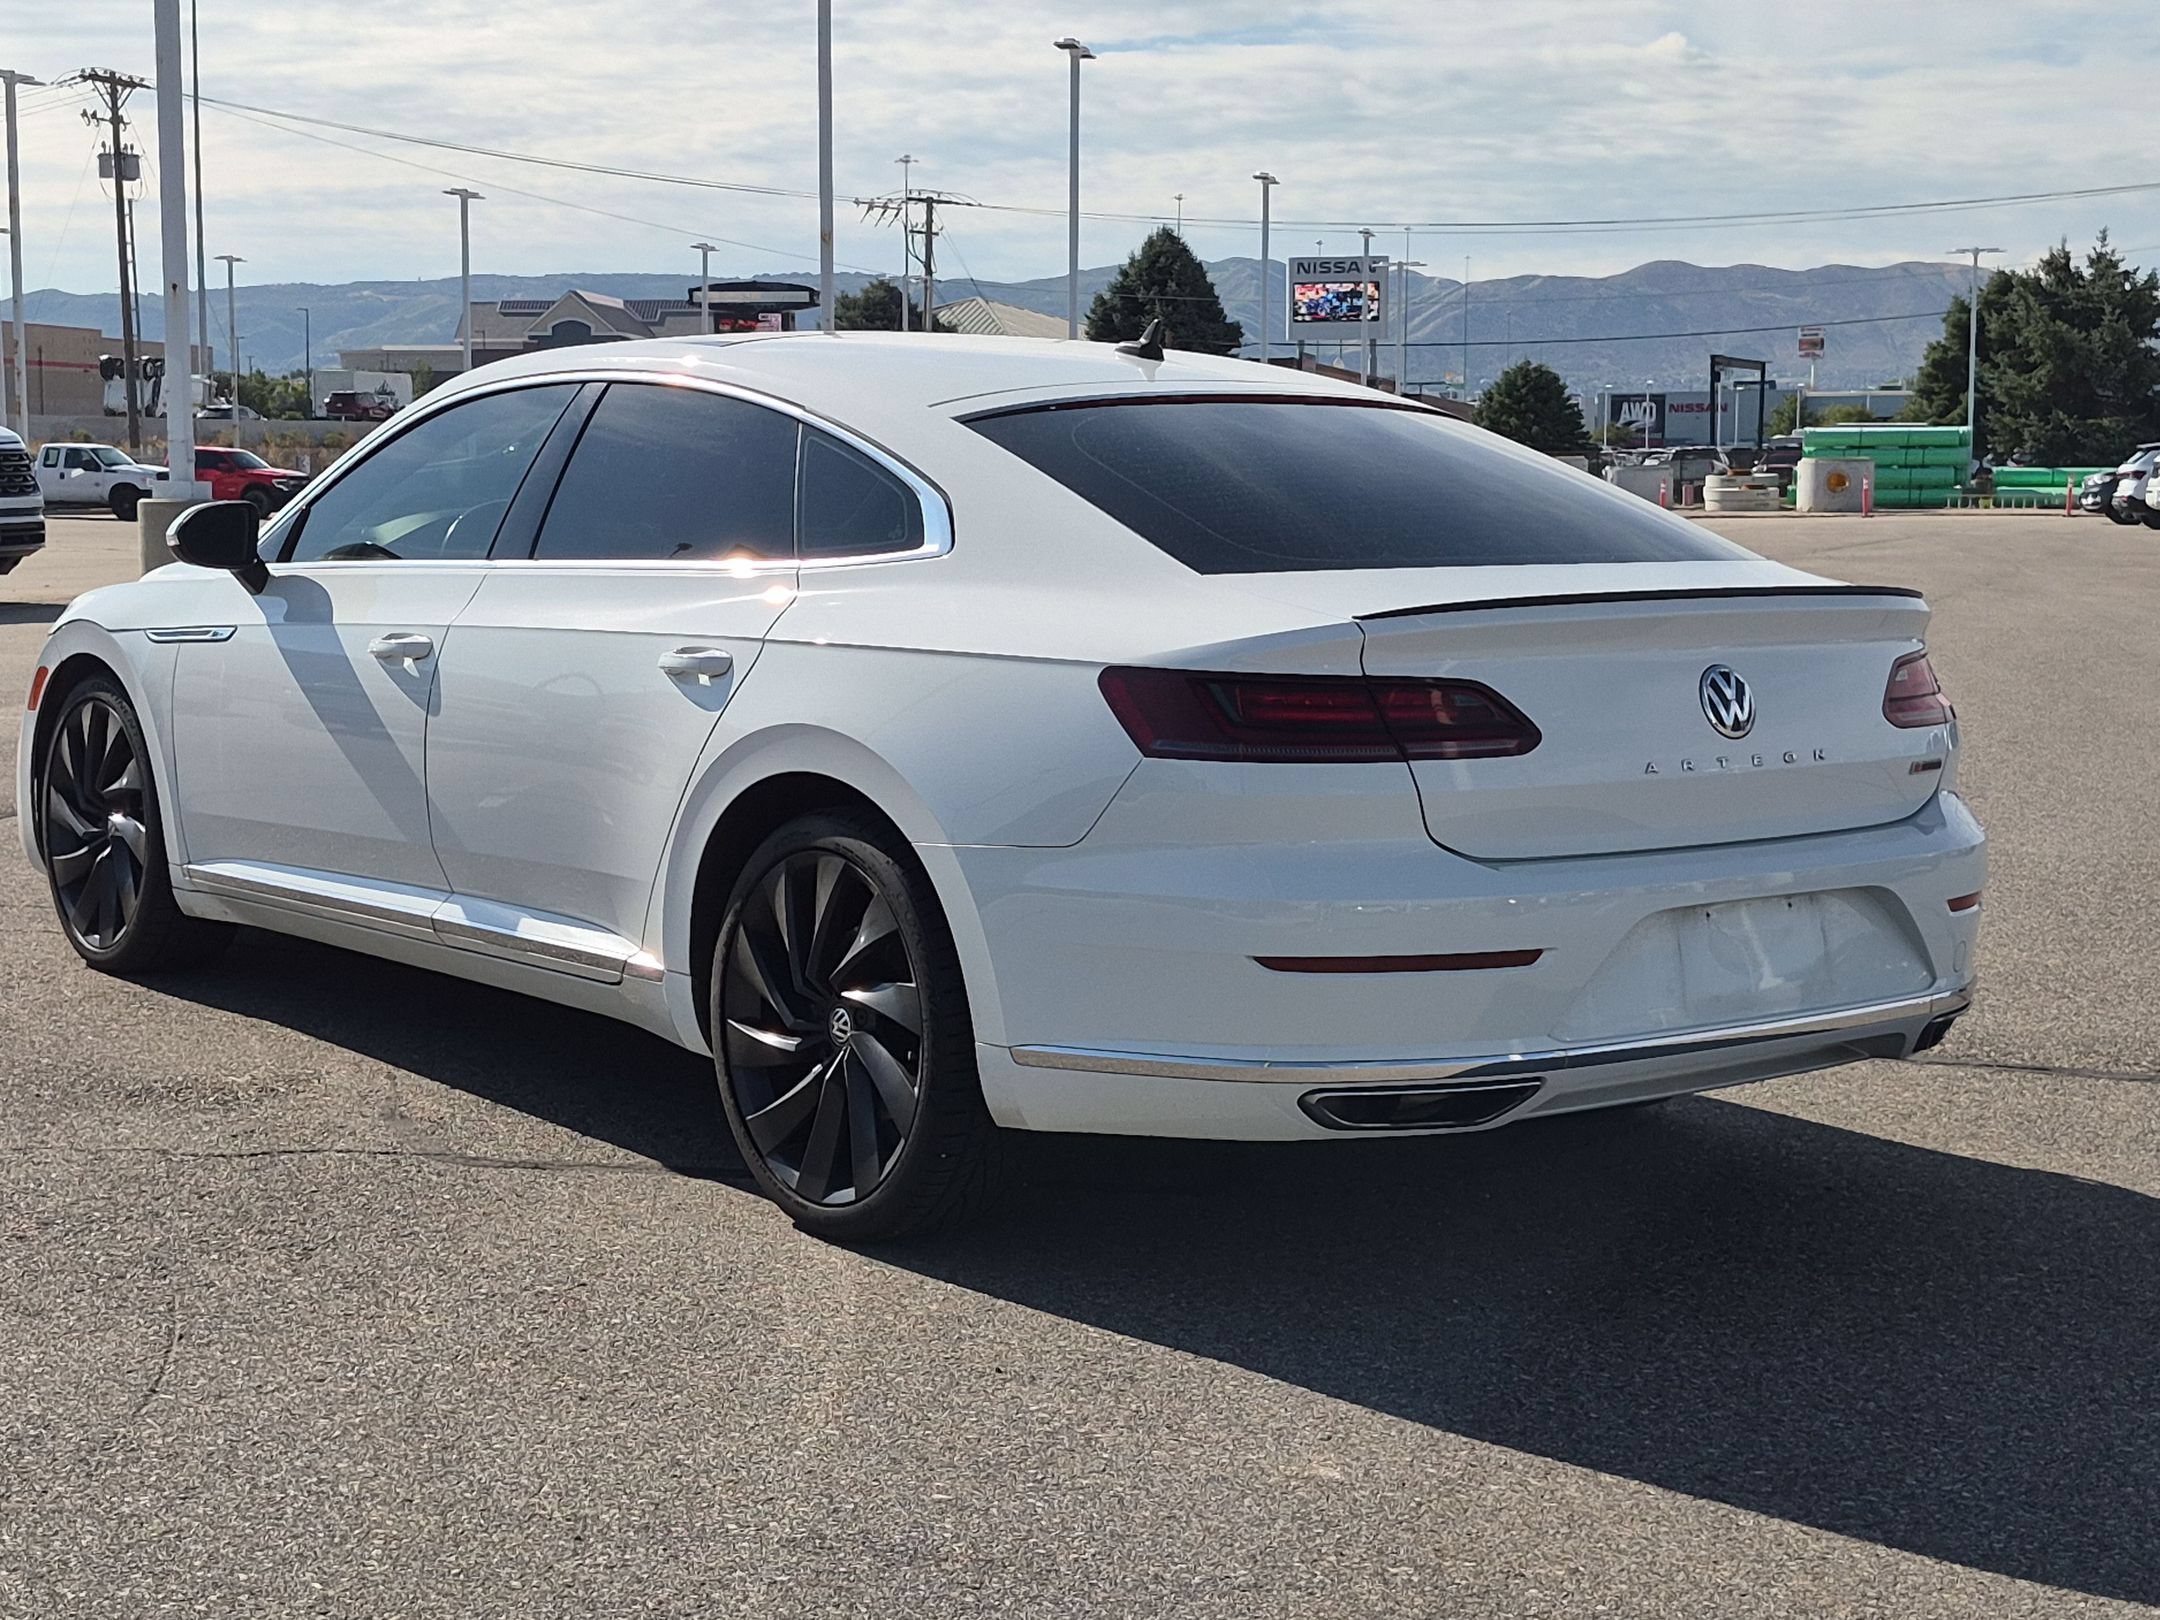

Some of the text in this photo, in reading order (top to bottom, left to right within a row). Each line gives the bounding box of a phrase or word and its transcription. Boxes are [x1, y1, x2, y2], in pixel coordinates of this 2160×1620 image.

[1618, 402, 1657, 424] AWD
[1669, 403, 1728, 413] NISSAN
[1644, 748, 1827, 775] ARTEON
